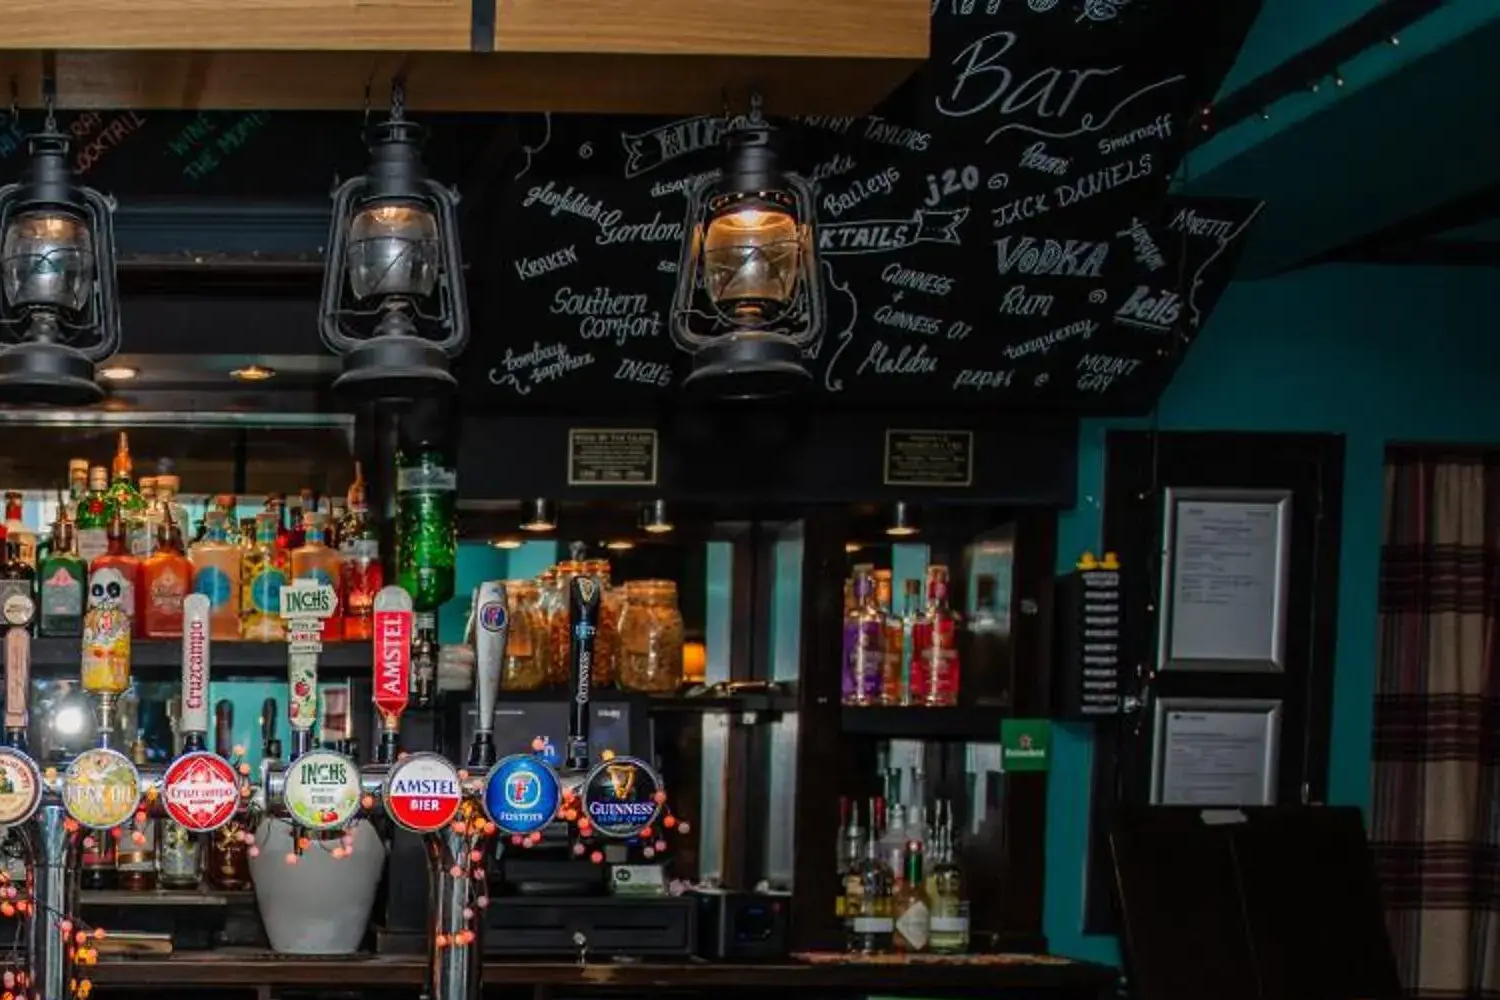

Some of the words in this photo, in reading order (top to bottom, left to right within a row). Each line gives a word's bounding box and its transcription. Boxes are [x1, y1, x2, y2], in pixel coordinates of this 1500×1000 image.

[935, 31, 1123, 118] Bar
[550, 286, 648, 316] Southern
[580, 311, 663, 347] Comfort
[382, 614, 402, 697] AMSTEL
[395, 780, 458, 794] AMSTEL
[409, 799, 441, 812] BIER
[589, 801, 655, 815] GUINNESS
